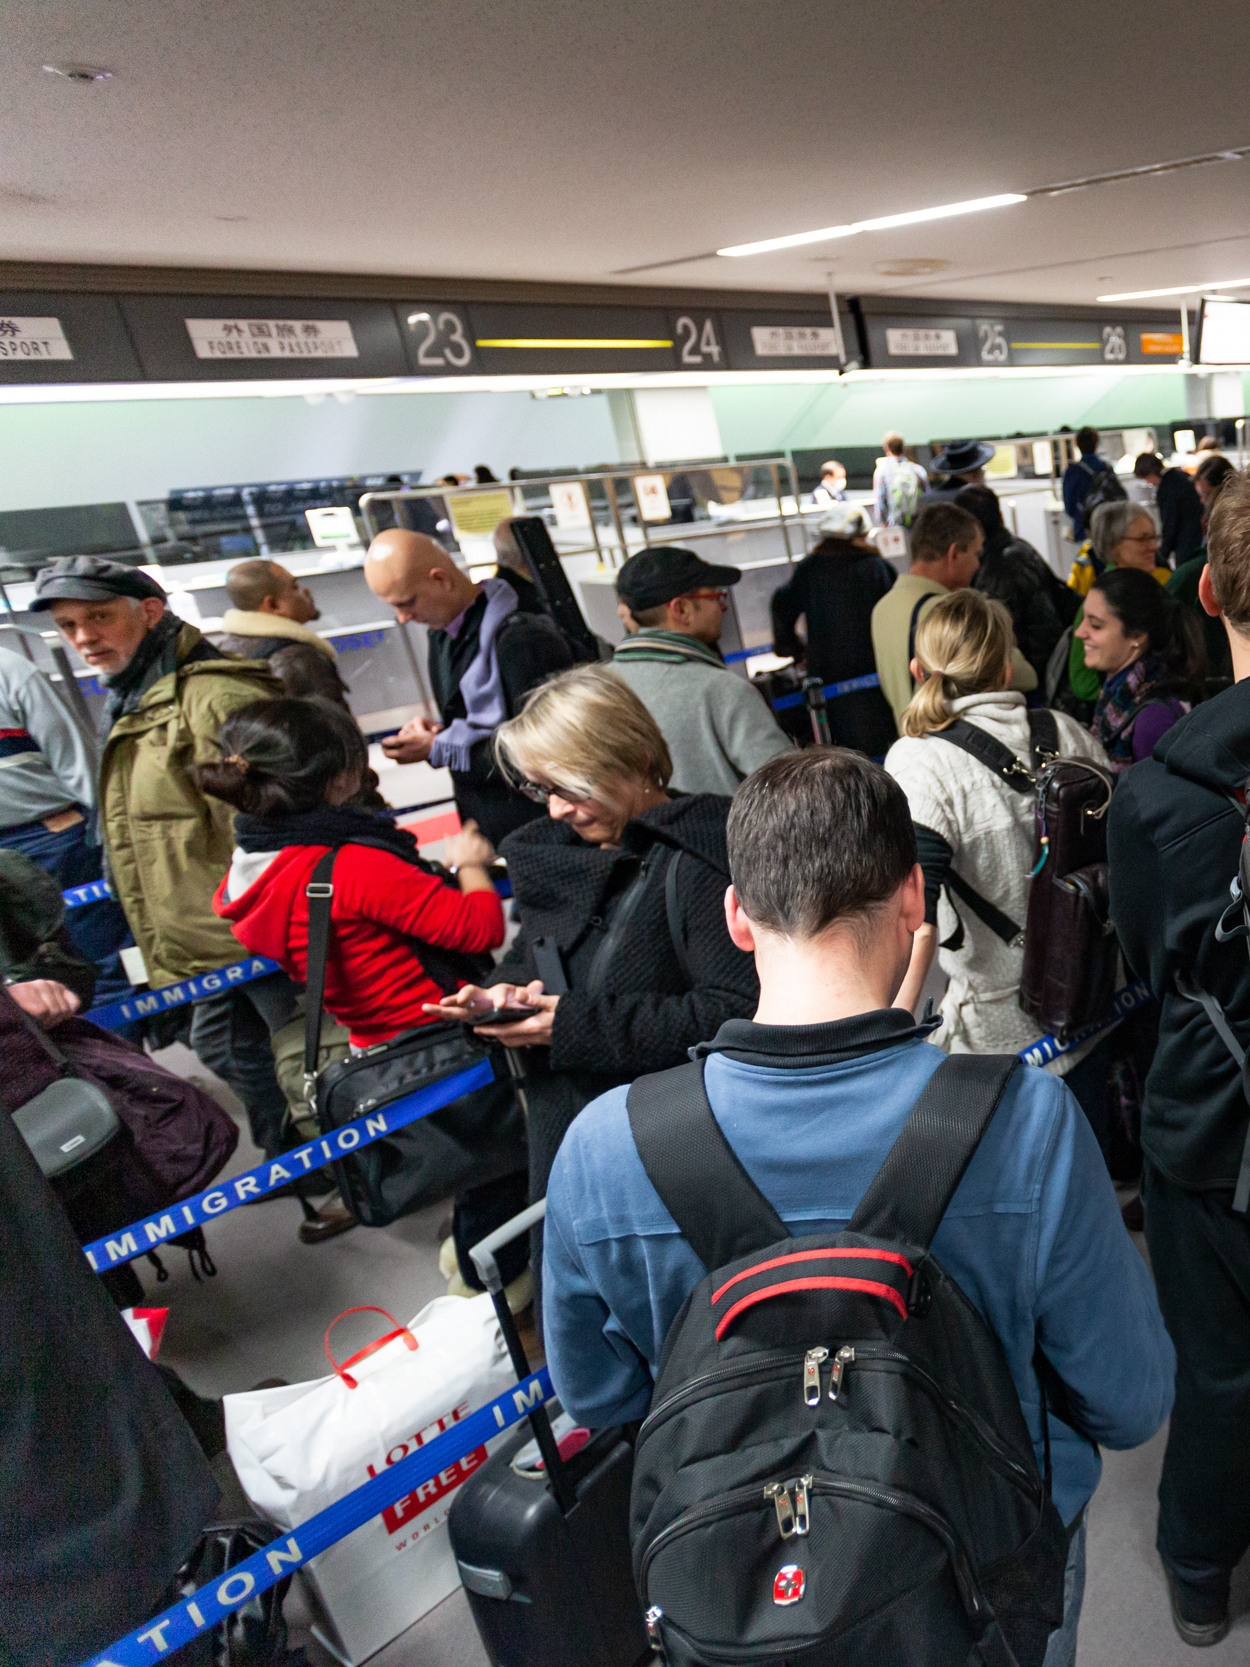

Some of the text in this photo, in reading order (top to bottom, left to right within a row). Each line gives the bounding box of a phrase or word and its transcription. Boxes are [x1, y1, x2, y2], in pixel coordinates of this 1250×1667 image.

[207, 340, 342, 355] FOREIGN PASSPORT
[417, 312, 471, 367] 23
[677, 316, 722, 365] 24
[979, 324, 1008, 361] 25
[1102, 326, 1127, 360] 26
[393, 1452, 479, 1519] FREE
[95, 1537, 303, 1667] TION
